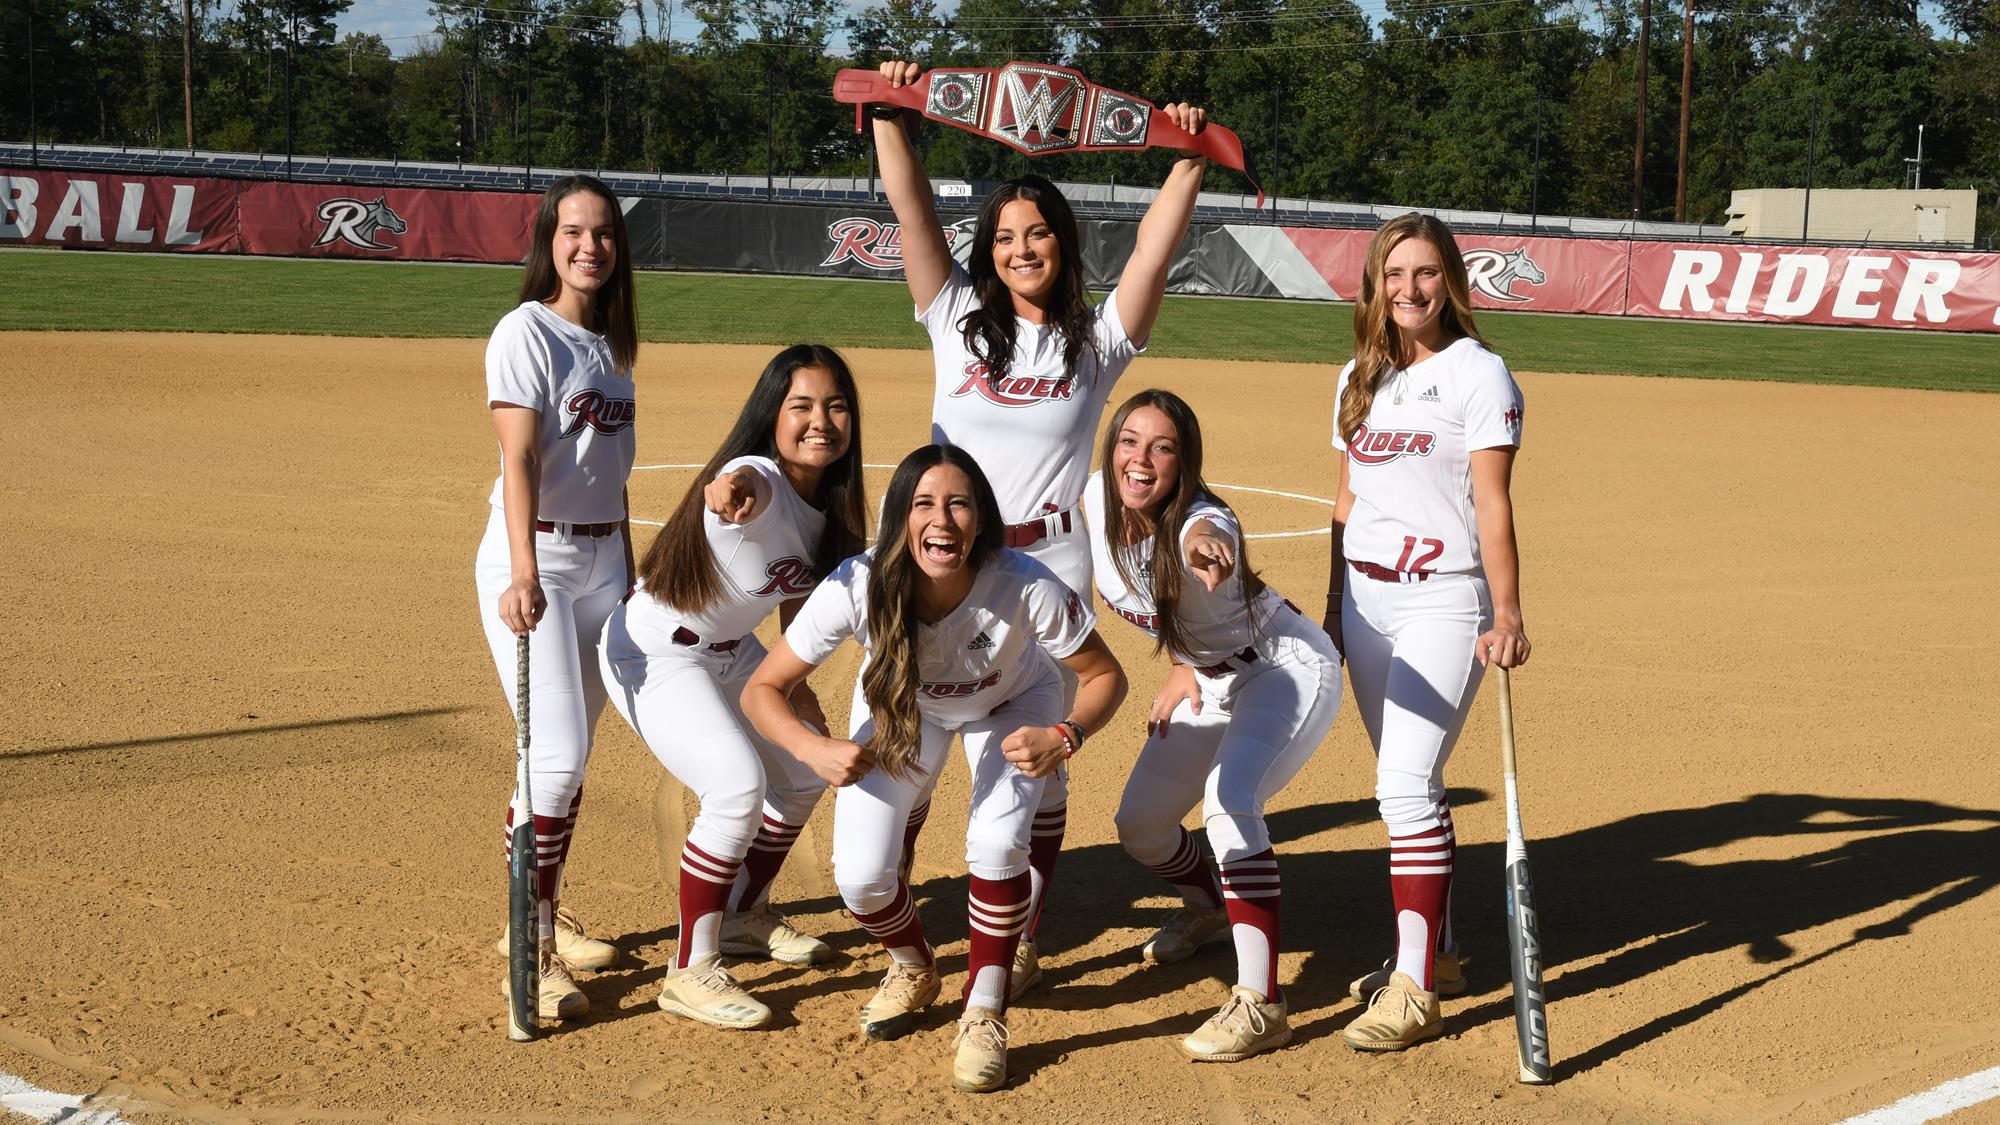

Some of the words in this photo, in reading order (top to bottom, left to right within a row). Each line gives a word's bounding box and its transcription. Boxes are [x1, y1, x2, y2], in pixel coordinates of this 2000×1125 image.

[0, 176, 203, 246] BALL
[947, 185, 966, 196] 220
[312, 198, 399, 252] R
[1659, 249, 1961, 324] RIDER
[560, 388, 635, 439] RIDE
[1395, 536, 1444, 573] 12
[967, 641, 996, 650] adidas
[919, 669, 1001, 699] IDER
[1520, 904, 1550, 1067] EASTON
